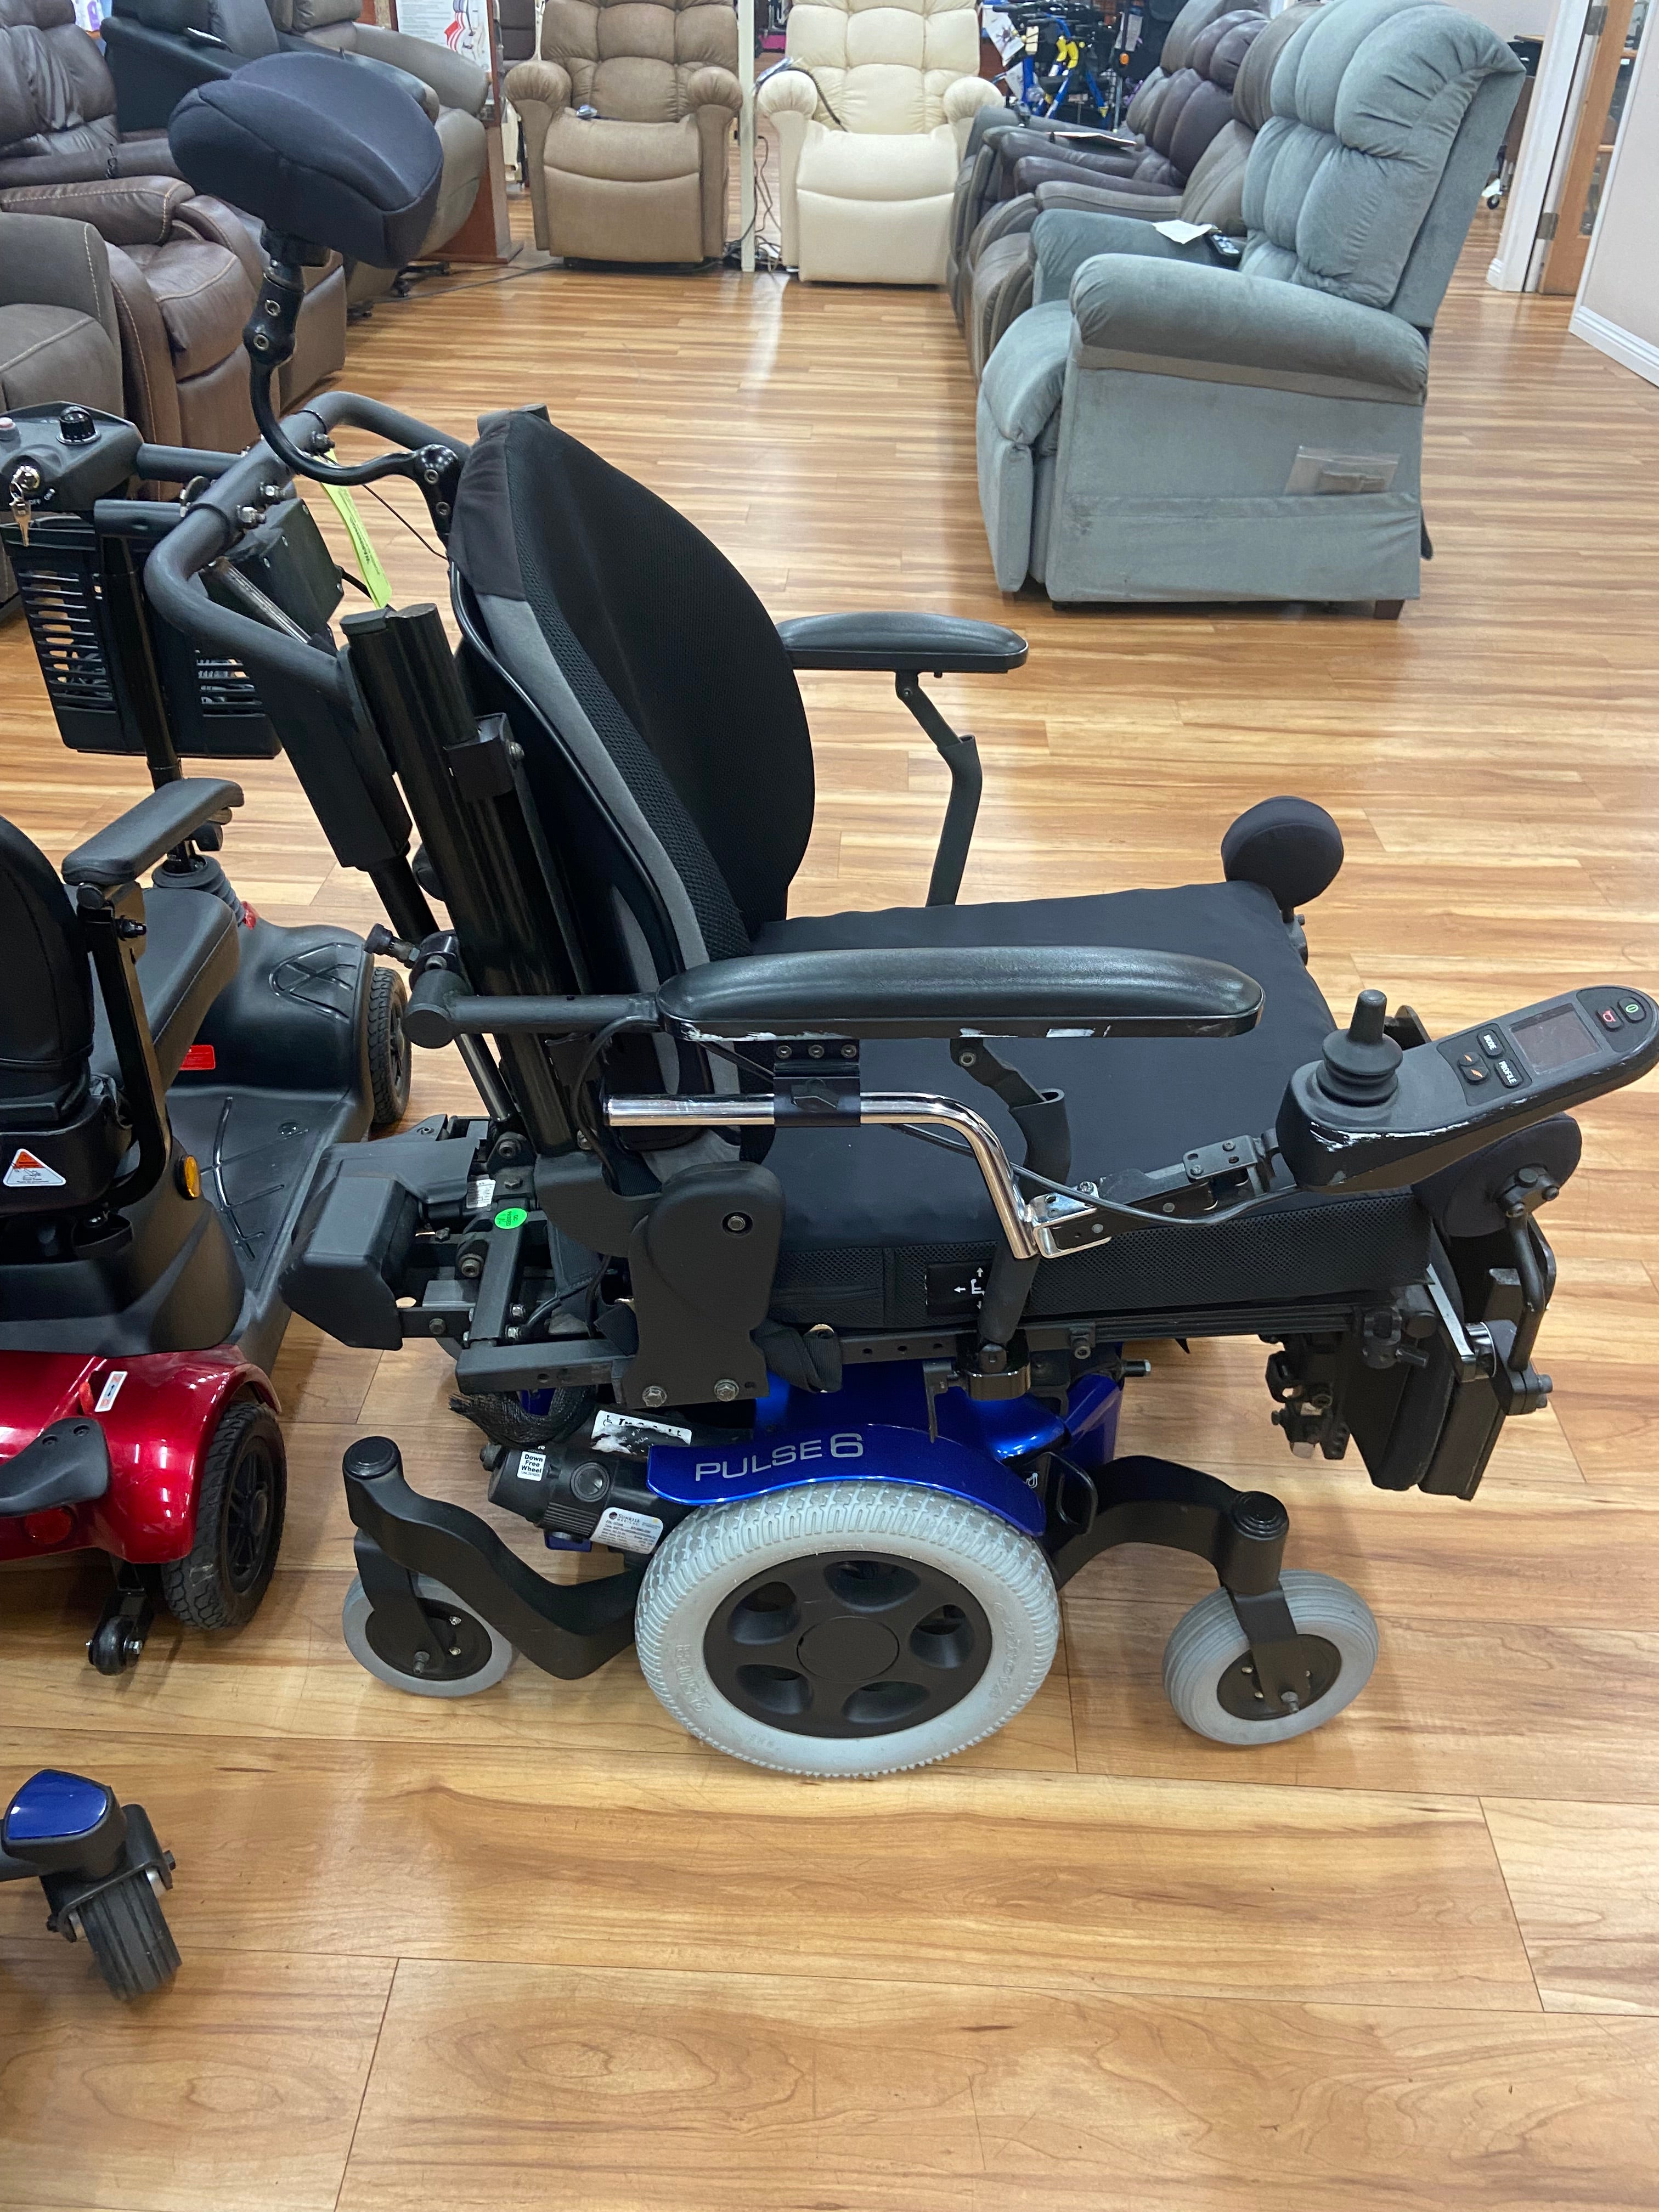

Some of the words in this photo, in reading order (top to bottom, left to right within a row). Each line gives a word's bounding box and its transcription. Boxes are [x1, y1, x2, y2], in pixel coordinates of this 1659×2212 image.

[1483, 1034, 1497, 1051] MODE
[1498, 1060, 1517, 1084] PROFILE
[524, 1454, 543, 1462] Down
[521, 1465, 542, 1474] Wheel
